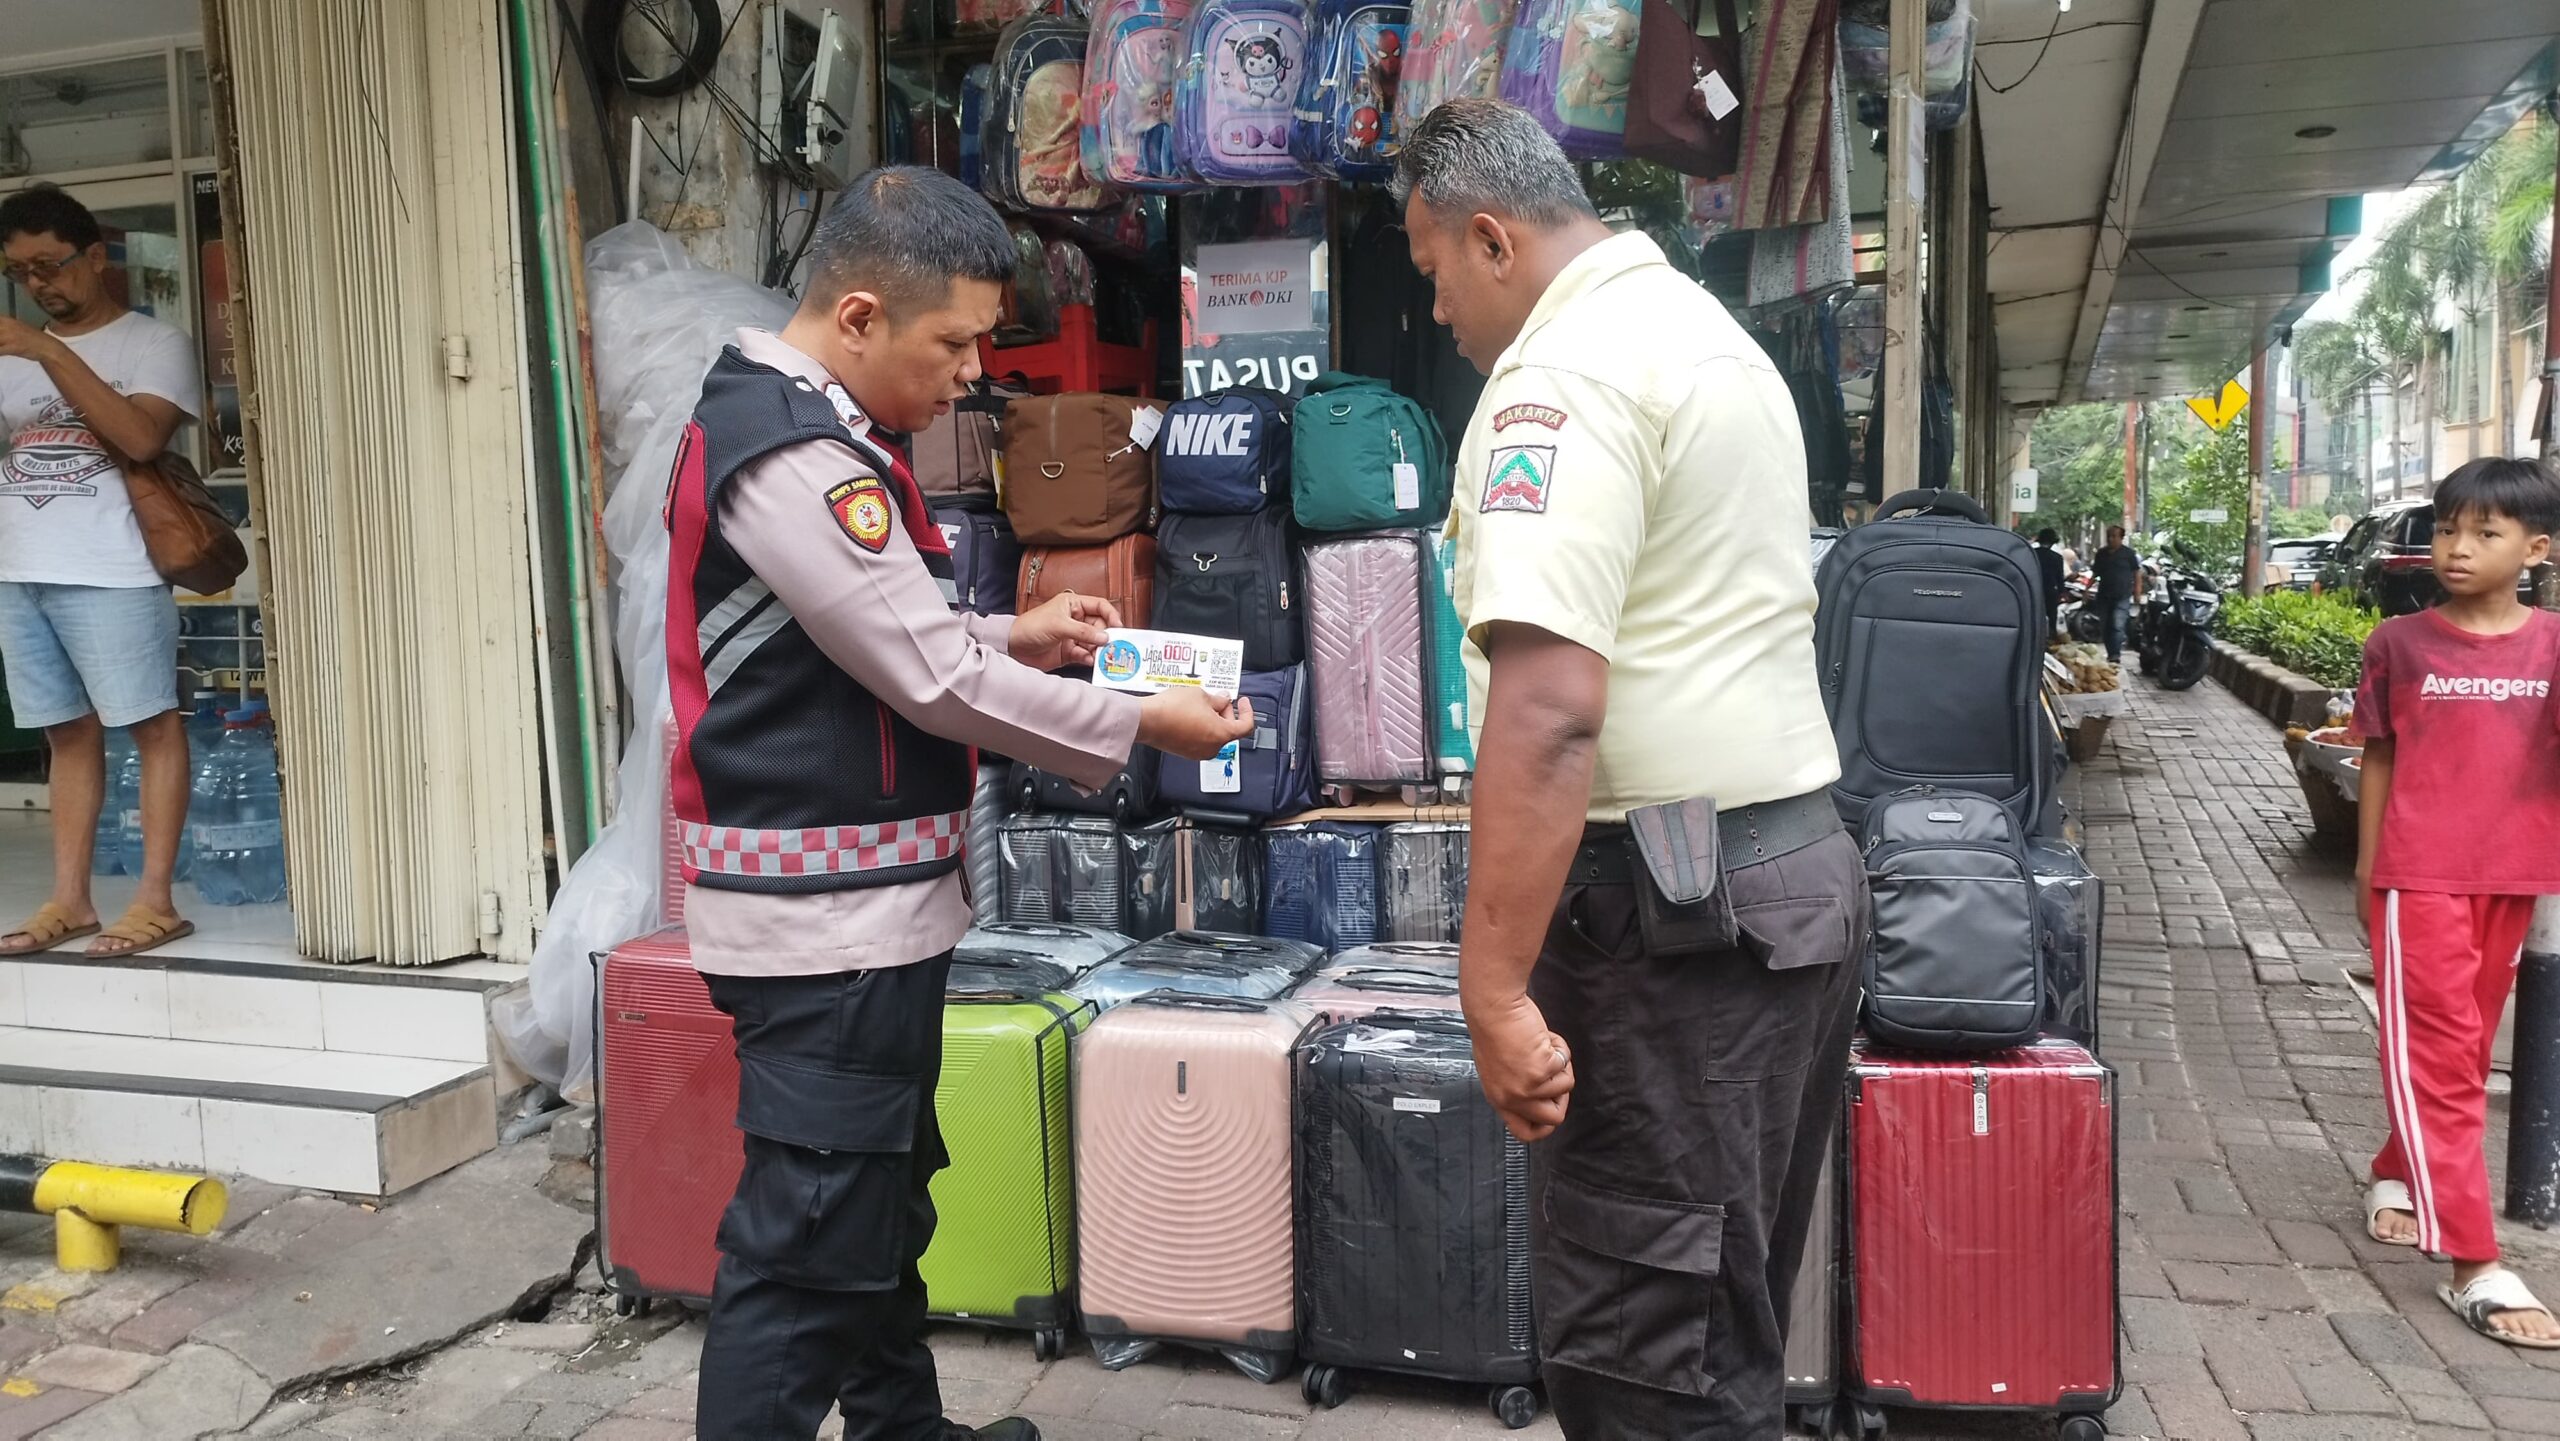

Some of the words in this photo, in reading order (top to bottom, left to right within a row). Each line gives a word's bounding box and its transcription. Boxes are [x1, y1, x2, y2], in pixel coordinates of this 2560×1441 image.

[1210, 273, 1262, 287] TERIMA
[1265, 270, 1288, 284] KJP
[1207, 291, 1249, 308] BANK
[1265, 290, 1294, 305] DKI
[1497, 406, 1562, 426] JAKARTA
[1166, 413, 1254, 456] NIKE
[21, 458, 52, 471] BRAZIL
[55, 459, 80, 471] 1975
[1142, 646, 1163, 662] JAGA
[1164, 645, 1192, 661] 110
[2420, 673, 2550, 701] Avengers
